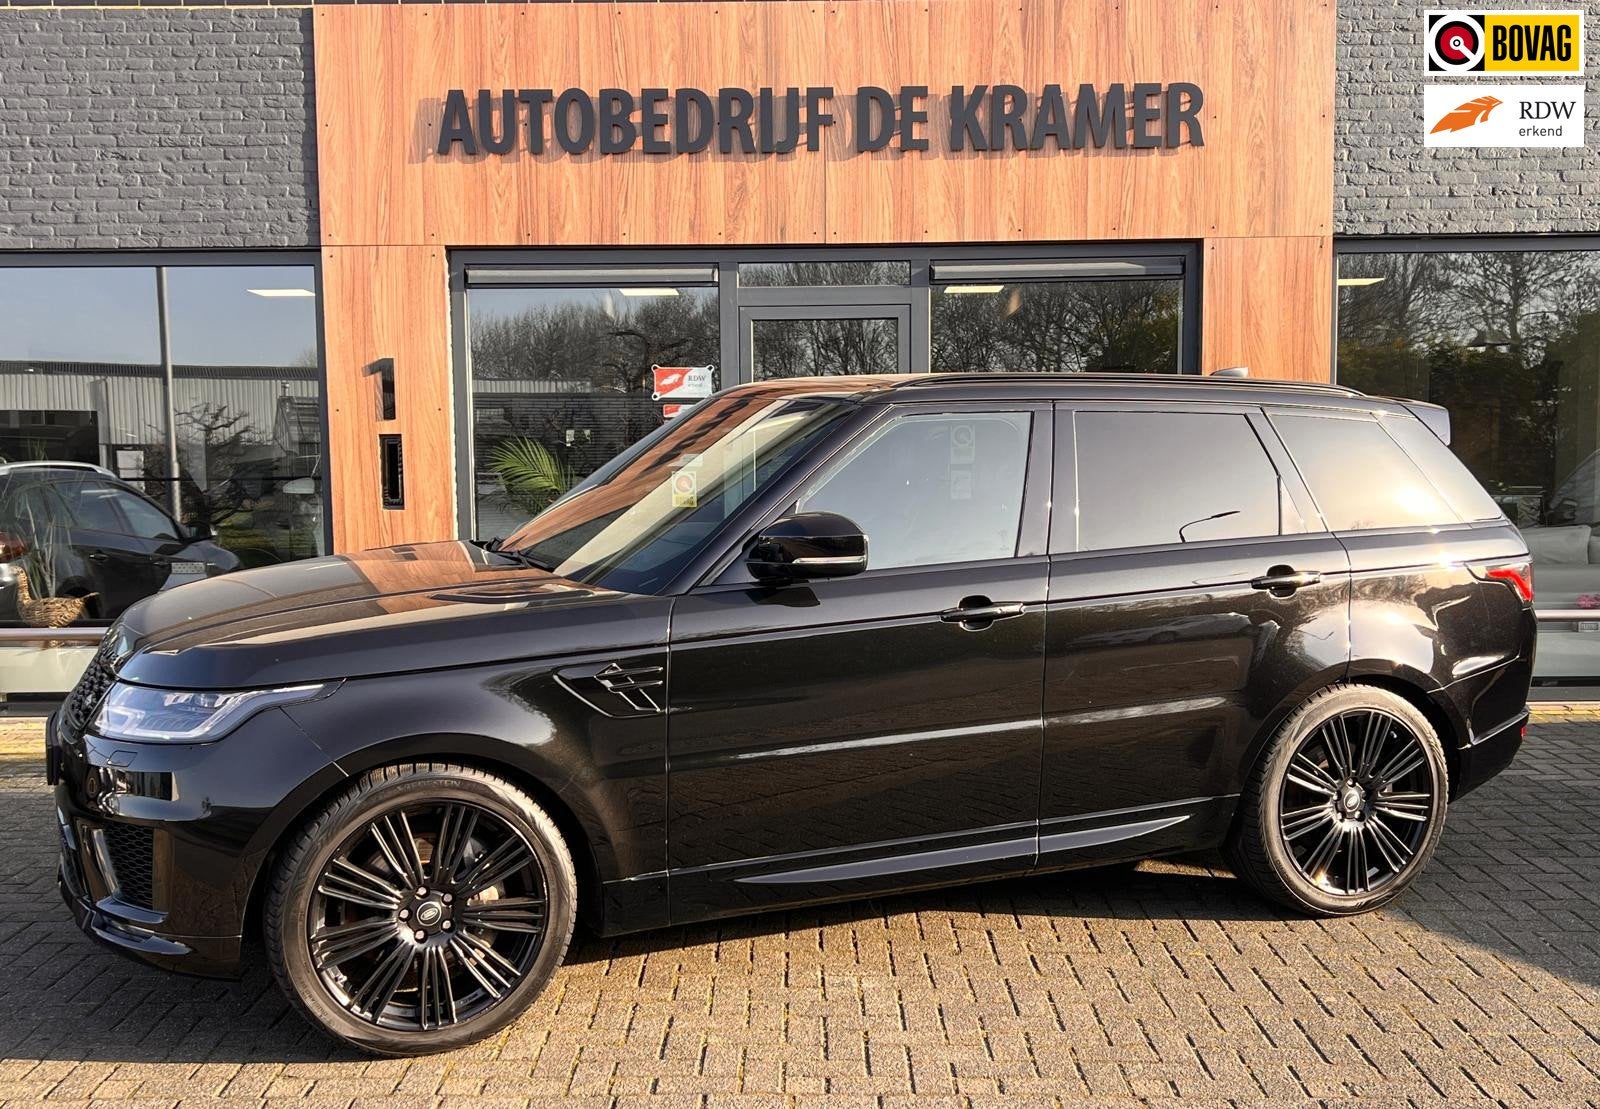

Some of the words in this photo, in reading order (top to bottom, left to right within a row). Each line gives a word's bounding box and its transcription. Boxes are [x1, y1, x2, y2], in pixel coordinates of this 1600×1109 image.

[437, 86, 834, 155] AUTOBEDRIJF
[857, 84, 929, 152] DE
[950, 82, 1204, 152] KRAMER
